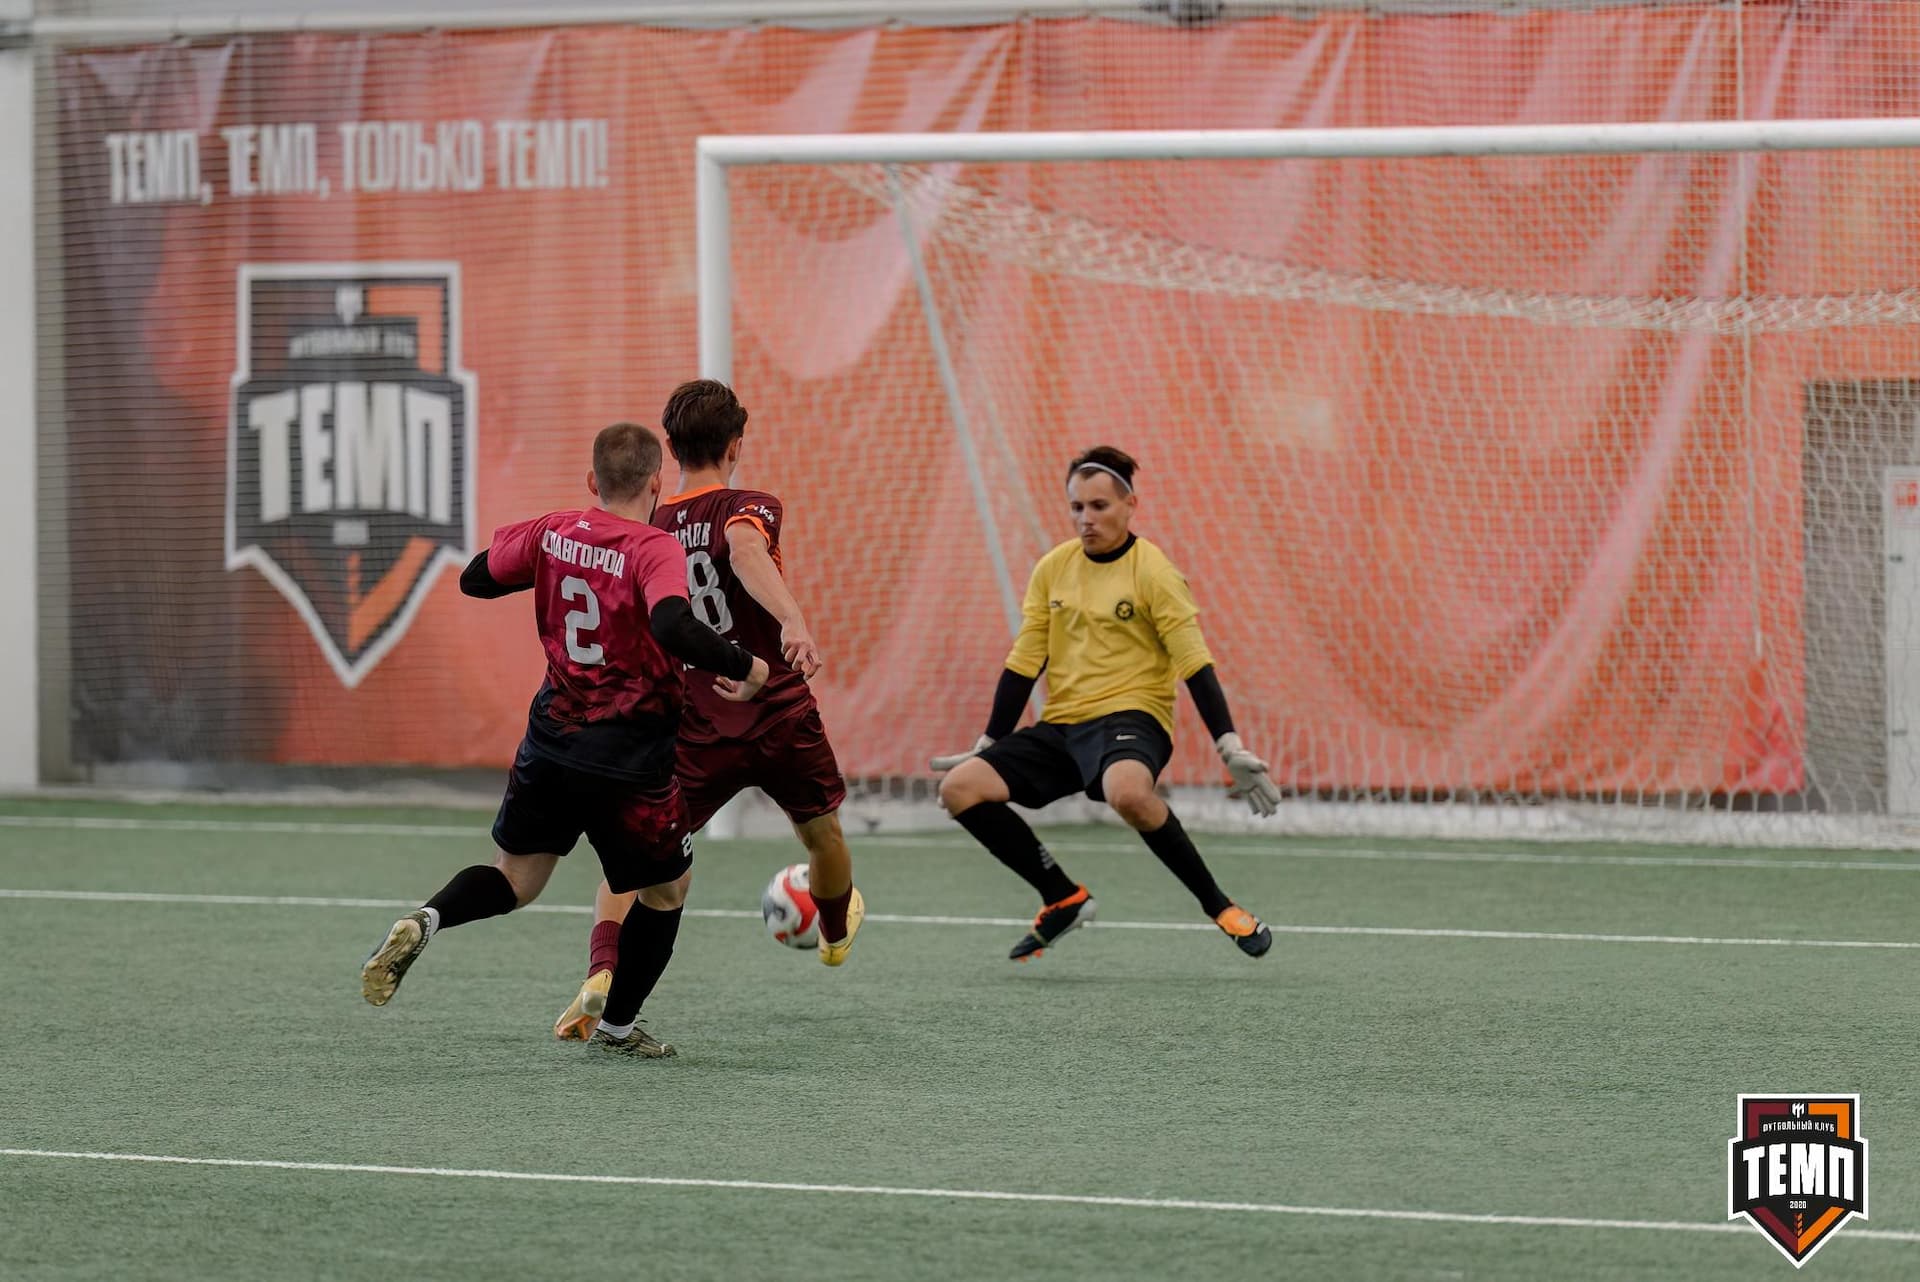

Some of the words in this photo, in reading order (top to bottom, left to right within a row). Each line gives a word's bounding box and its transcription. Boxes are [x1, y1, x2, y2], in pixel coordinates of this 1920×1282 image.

[106, 130, 213, 206] ТЕМП,
[221, 125, 331, 200] ТЕМП,
[339, 119, 484, 193] ТОЛЬКО
[495, 119, 610, 188] ТЕМП!
[249, 382, 451, 524] ТЕМП
[542, 530, 625, 578] СЛАВГОРОД
[687, 551, 733, 634] 8
[561, 575, 605, 665] 2
